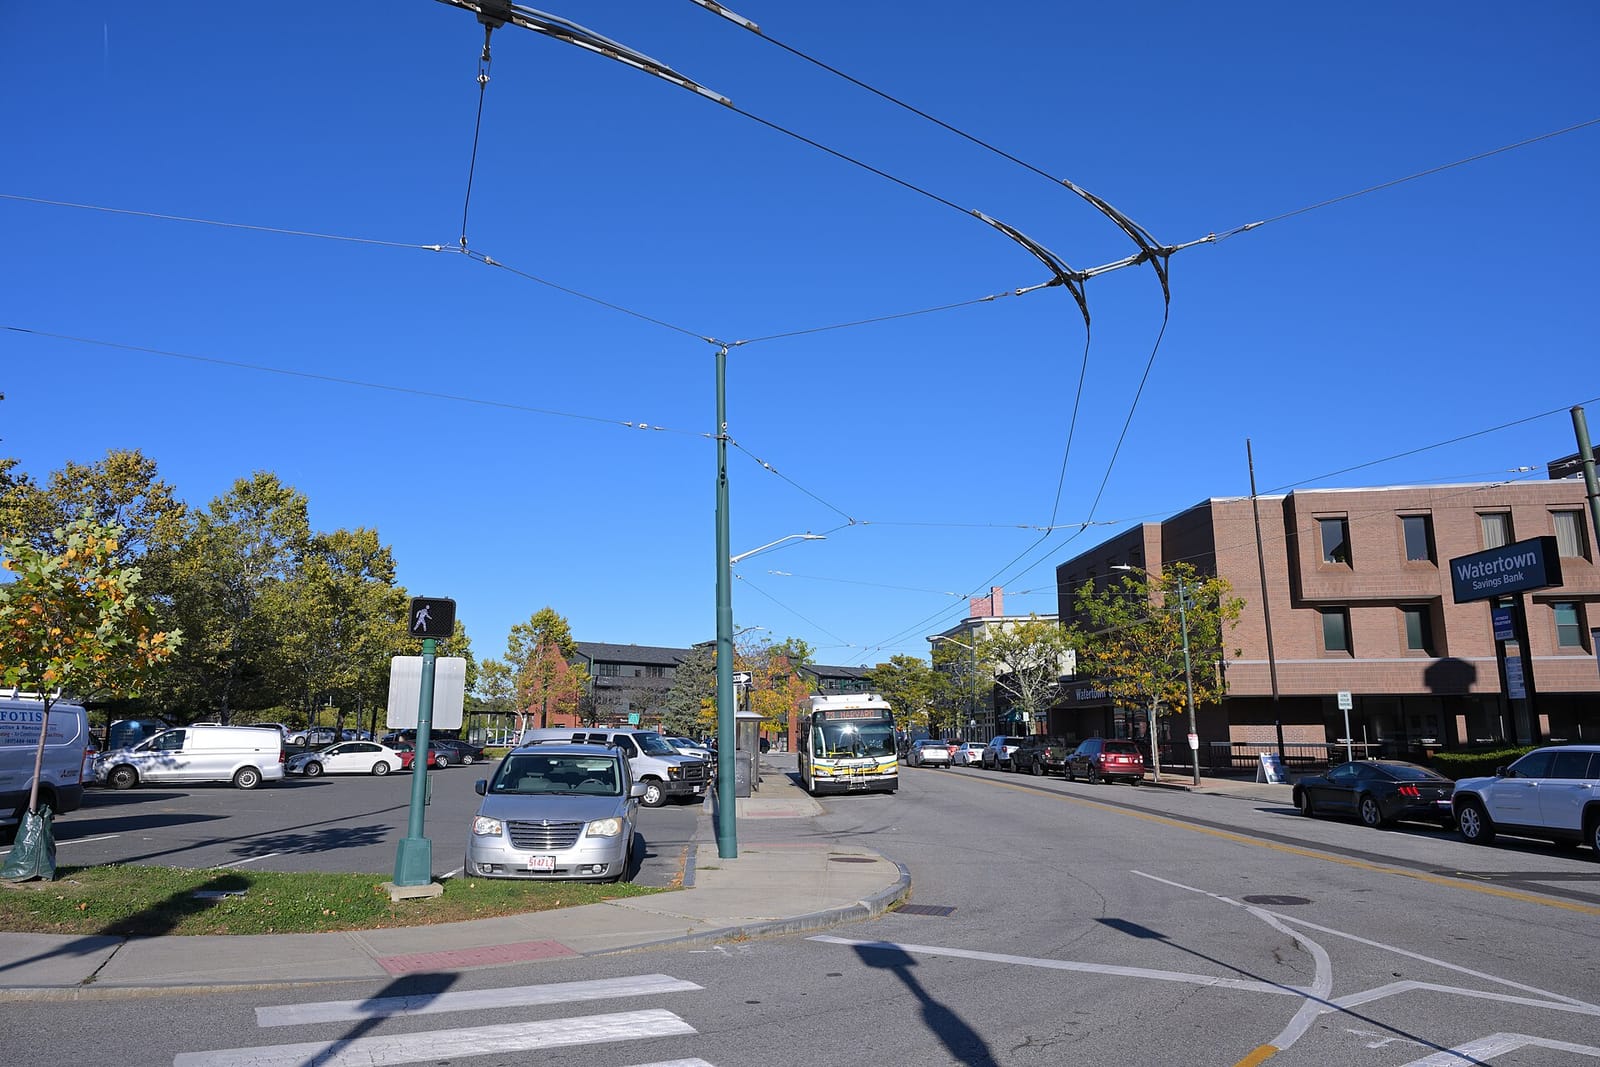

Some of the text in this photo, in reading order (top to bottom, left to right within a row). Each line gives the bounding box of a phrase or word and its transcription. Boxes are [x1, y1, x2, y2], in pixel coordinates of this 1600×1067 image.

[1457, 552, 1537, 580] Watertown
[1472, 571, 1524, 590] Savings Bank
[1076, 688, 1106, 701] Watertown
[0, 711, 42, 722] FOTIS
